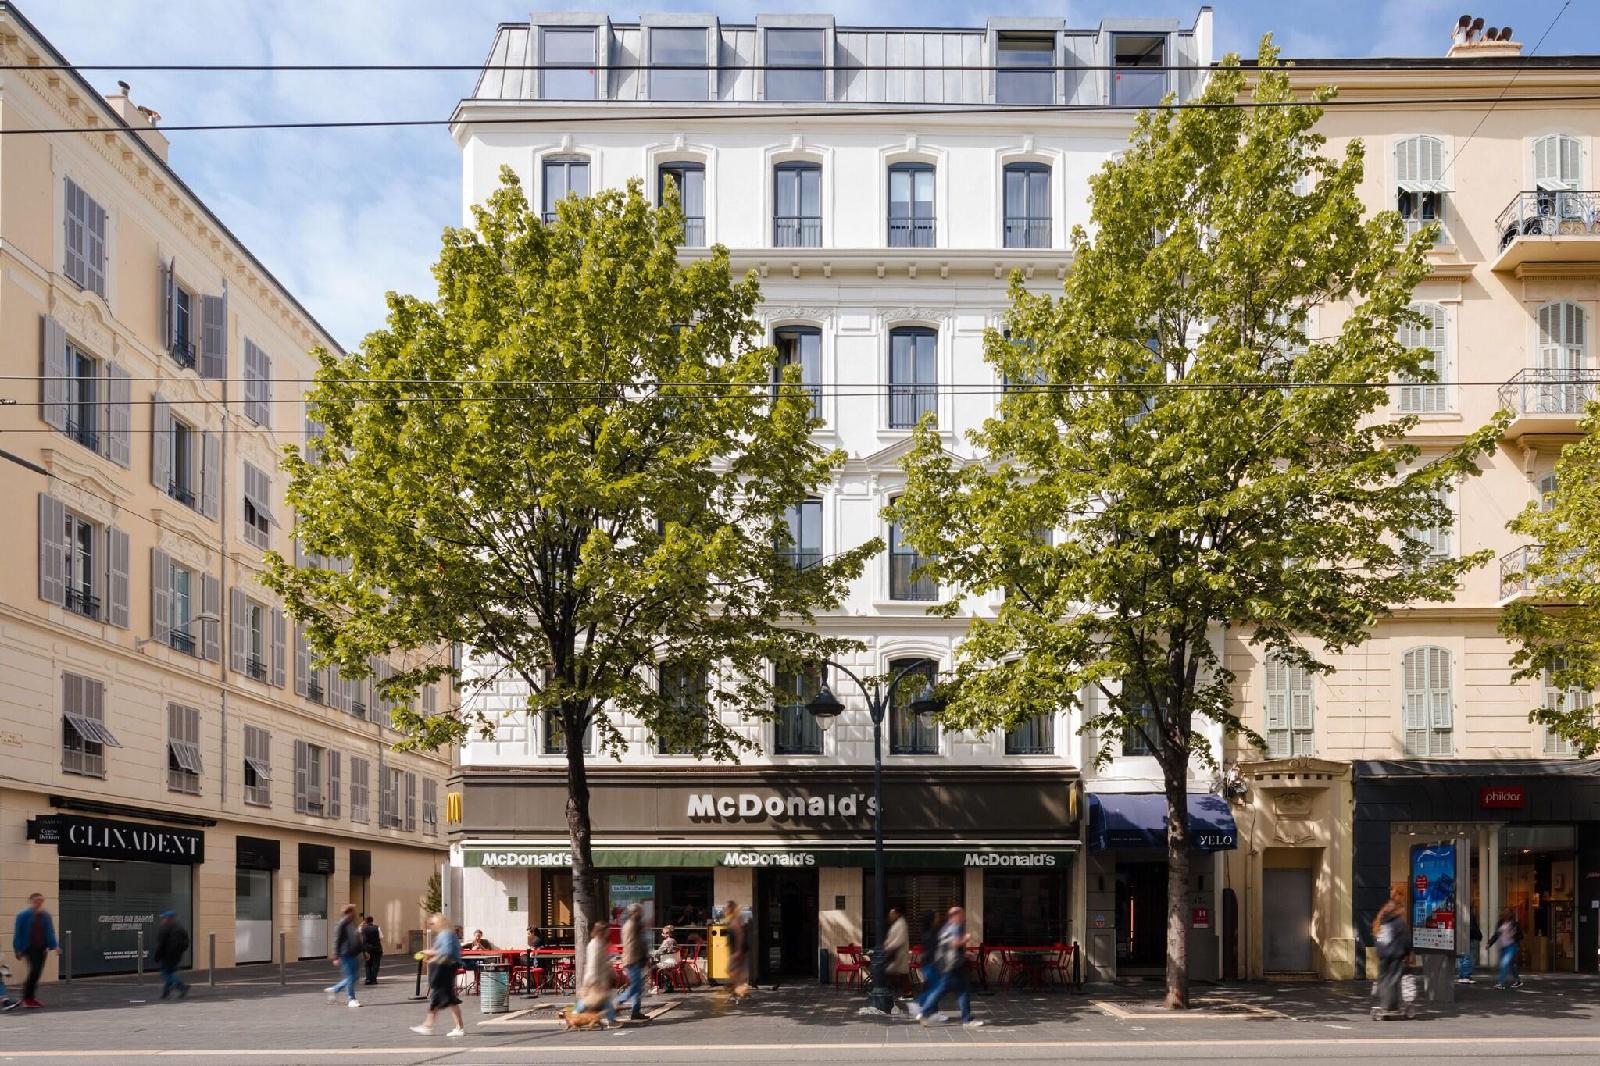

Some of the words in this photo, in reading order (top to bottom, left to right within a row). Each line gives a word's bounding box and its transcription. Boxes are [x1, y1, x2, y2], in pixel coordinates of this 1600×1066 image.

[687, 793, 876, 816] McDonald's
[1485, 791, 1520, 804] phildar
[69, 824, 199, 855] CLINADENT
[1200, 835, 1232, 845] YELO
[482, 852, 573, 866] McDonald's
[723, 852, 815, 866] McDonald's
[963, 853, 1056, 866] McDonald's
